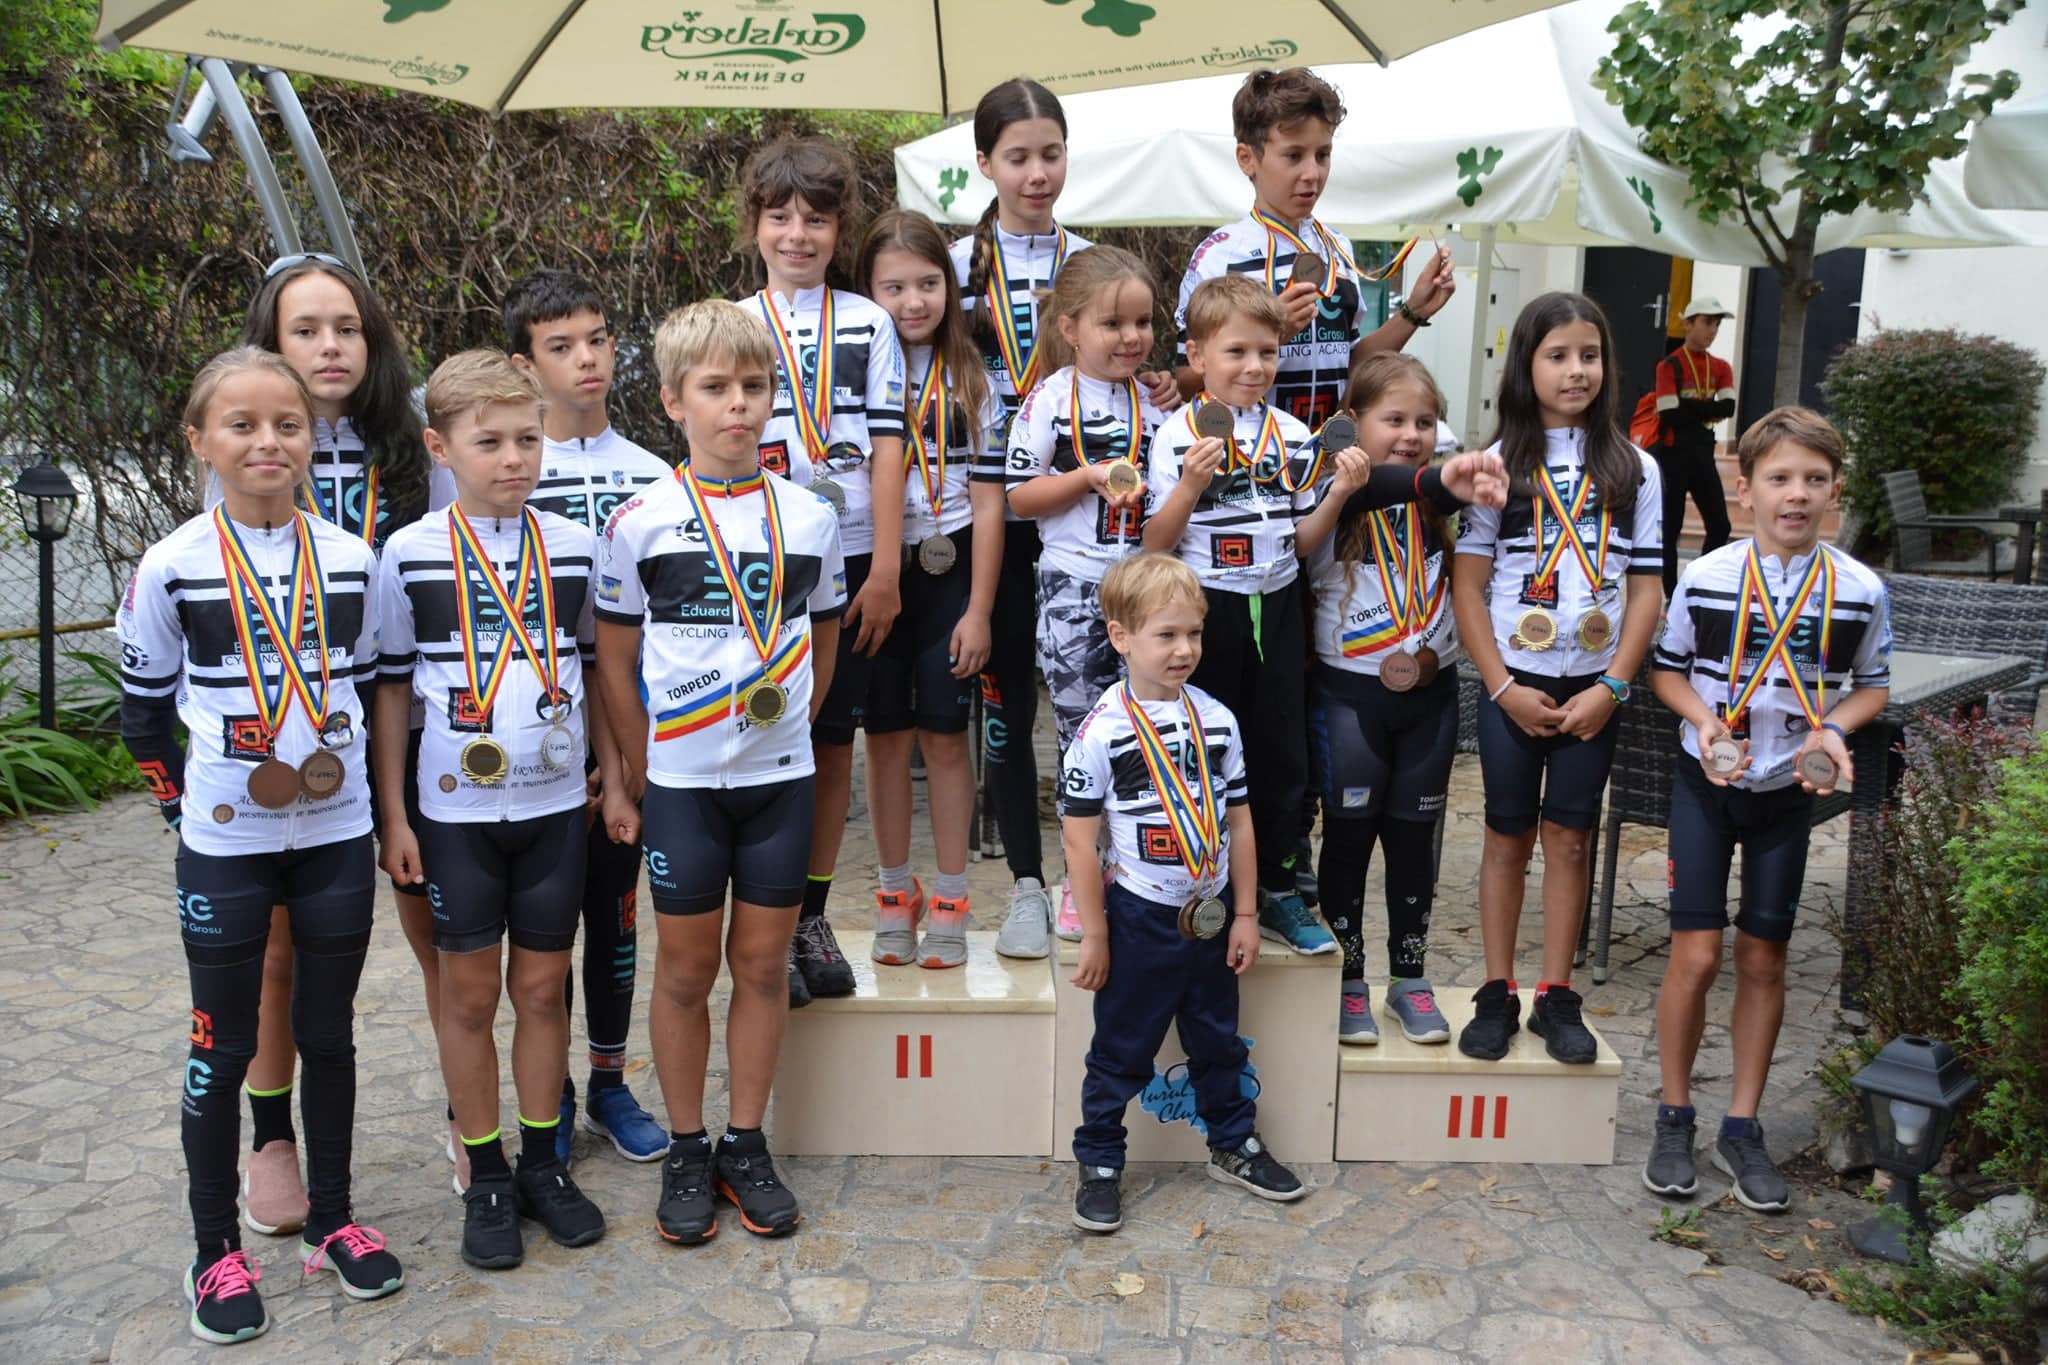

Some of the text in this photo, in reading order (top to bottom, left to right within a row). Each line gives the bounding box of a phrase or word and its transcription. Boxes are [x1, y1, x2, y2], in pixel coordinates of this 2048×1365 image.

[1317, 327, 1345, 341] Grosu
[681, 604, 730, 617] Eduard
[1350, 602, 1389, 625] TORPED
[671, 626, 728, 639] CYCLING
[666, 669, 721, 702] TORPEDO
